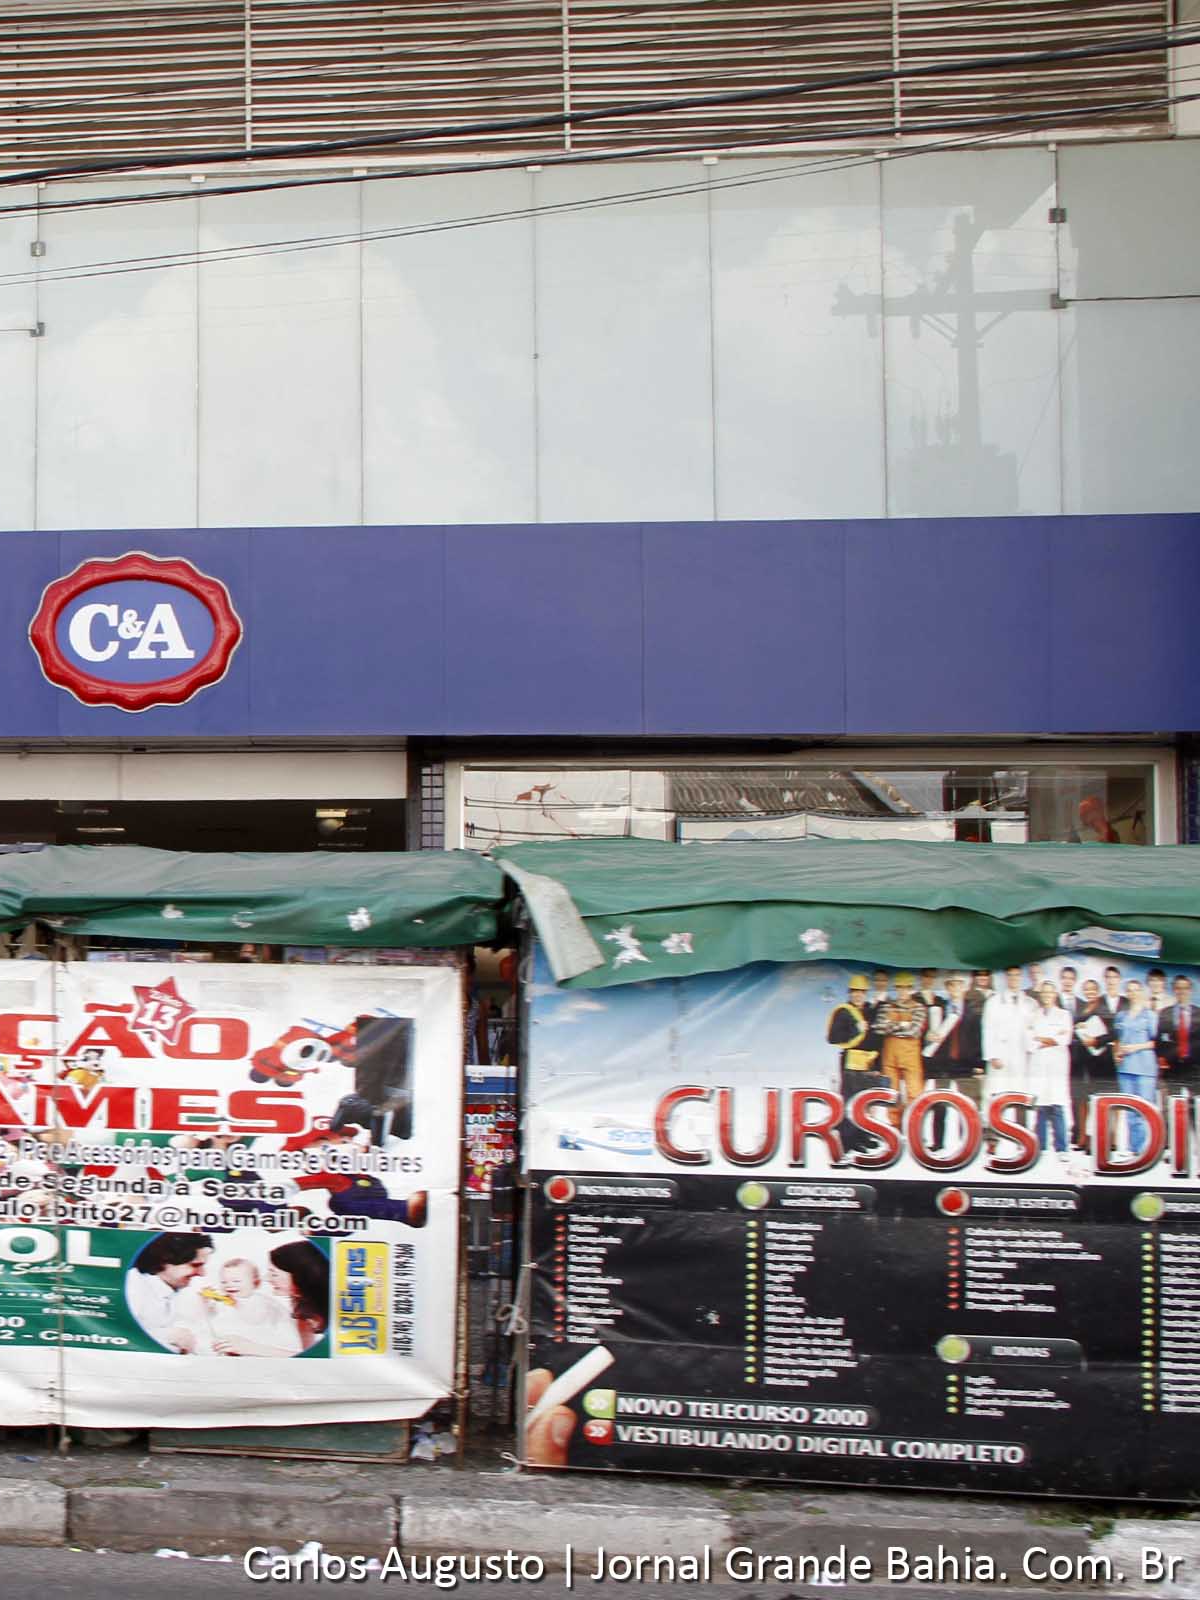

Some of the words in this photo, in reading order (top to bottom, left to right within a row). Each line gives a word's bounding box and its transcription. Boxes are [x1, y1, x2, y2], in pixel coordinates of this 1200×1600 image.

[68, 603, 195, 662] C&A
[136, 1001, 181, 1031] 13
[654, 1085, 1039, 1173] CURSOS
[1089, 1093, 1200, 1178] DI
[177, 1147, 225, 1174] para
[227, 1144, 304, 1171] Games
[326, 1147, 423, 1174] Celulares
[0, 1171, 31, 1188] de
[42, 1171, 163, 1195] Segunda
[202, 1179, 286, 1200] Sexta
[786, 1185, 856, 1198] CONCURSO
[39, 1330, 129, 1345] Centro
[991, 1345, 1051, 1358] IDIOMAS
[616, 1396, 683, 1417] NOVO
[686, 1400, 809, 1424] TELECURSO
[812, 1407, 869, 1427] 2000
[616, 1423, 793, 1452] VESTIBULANDO
[798, 1435, 889, 1457] DIGITAL
[892, 1440, 1024, 1464] COMPLETO
